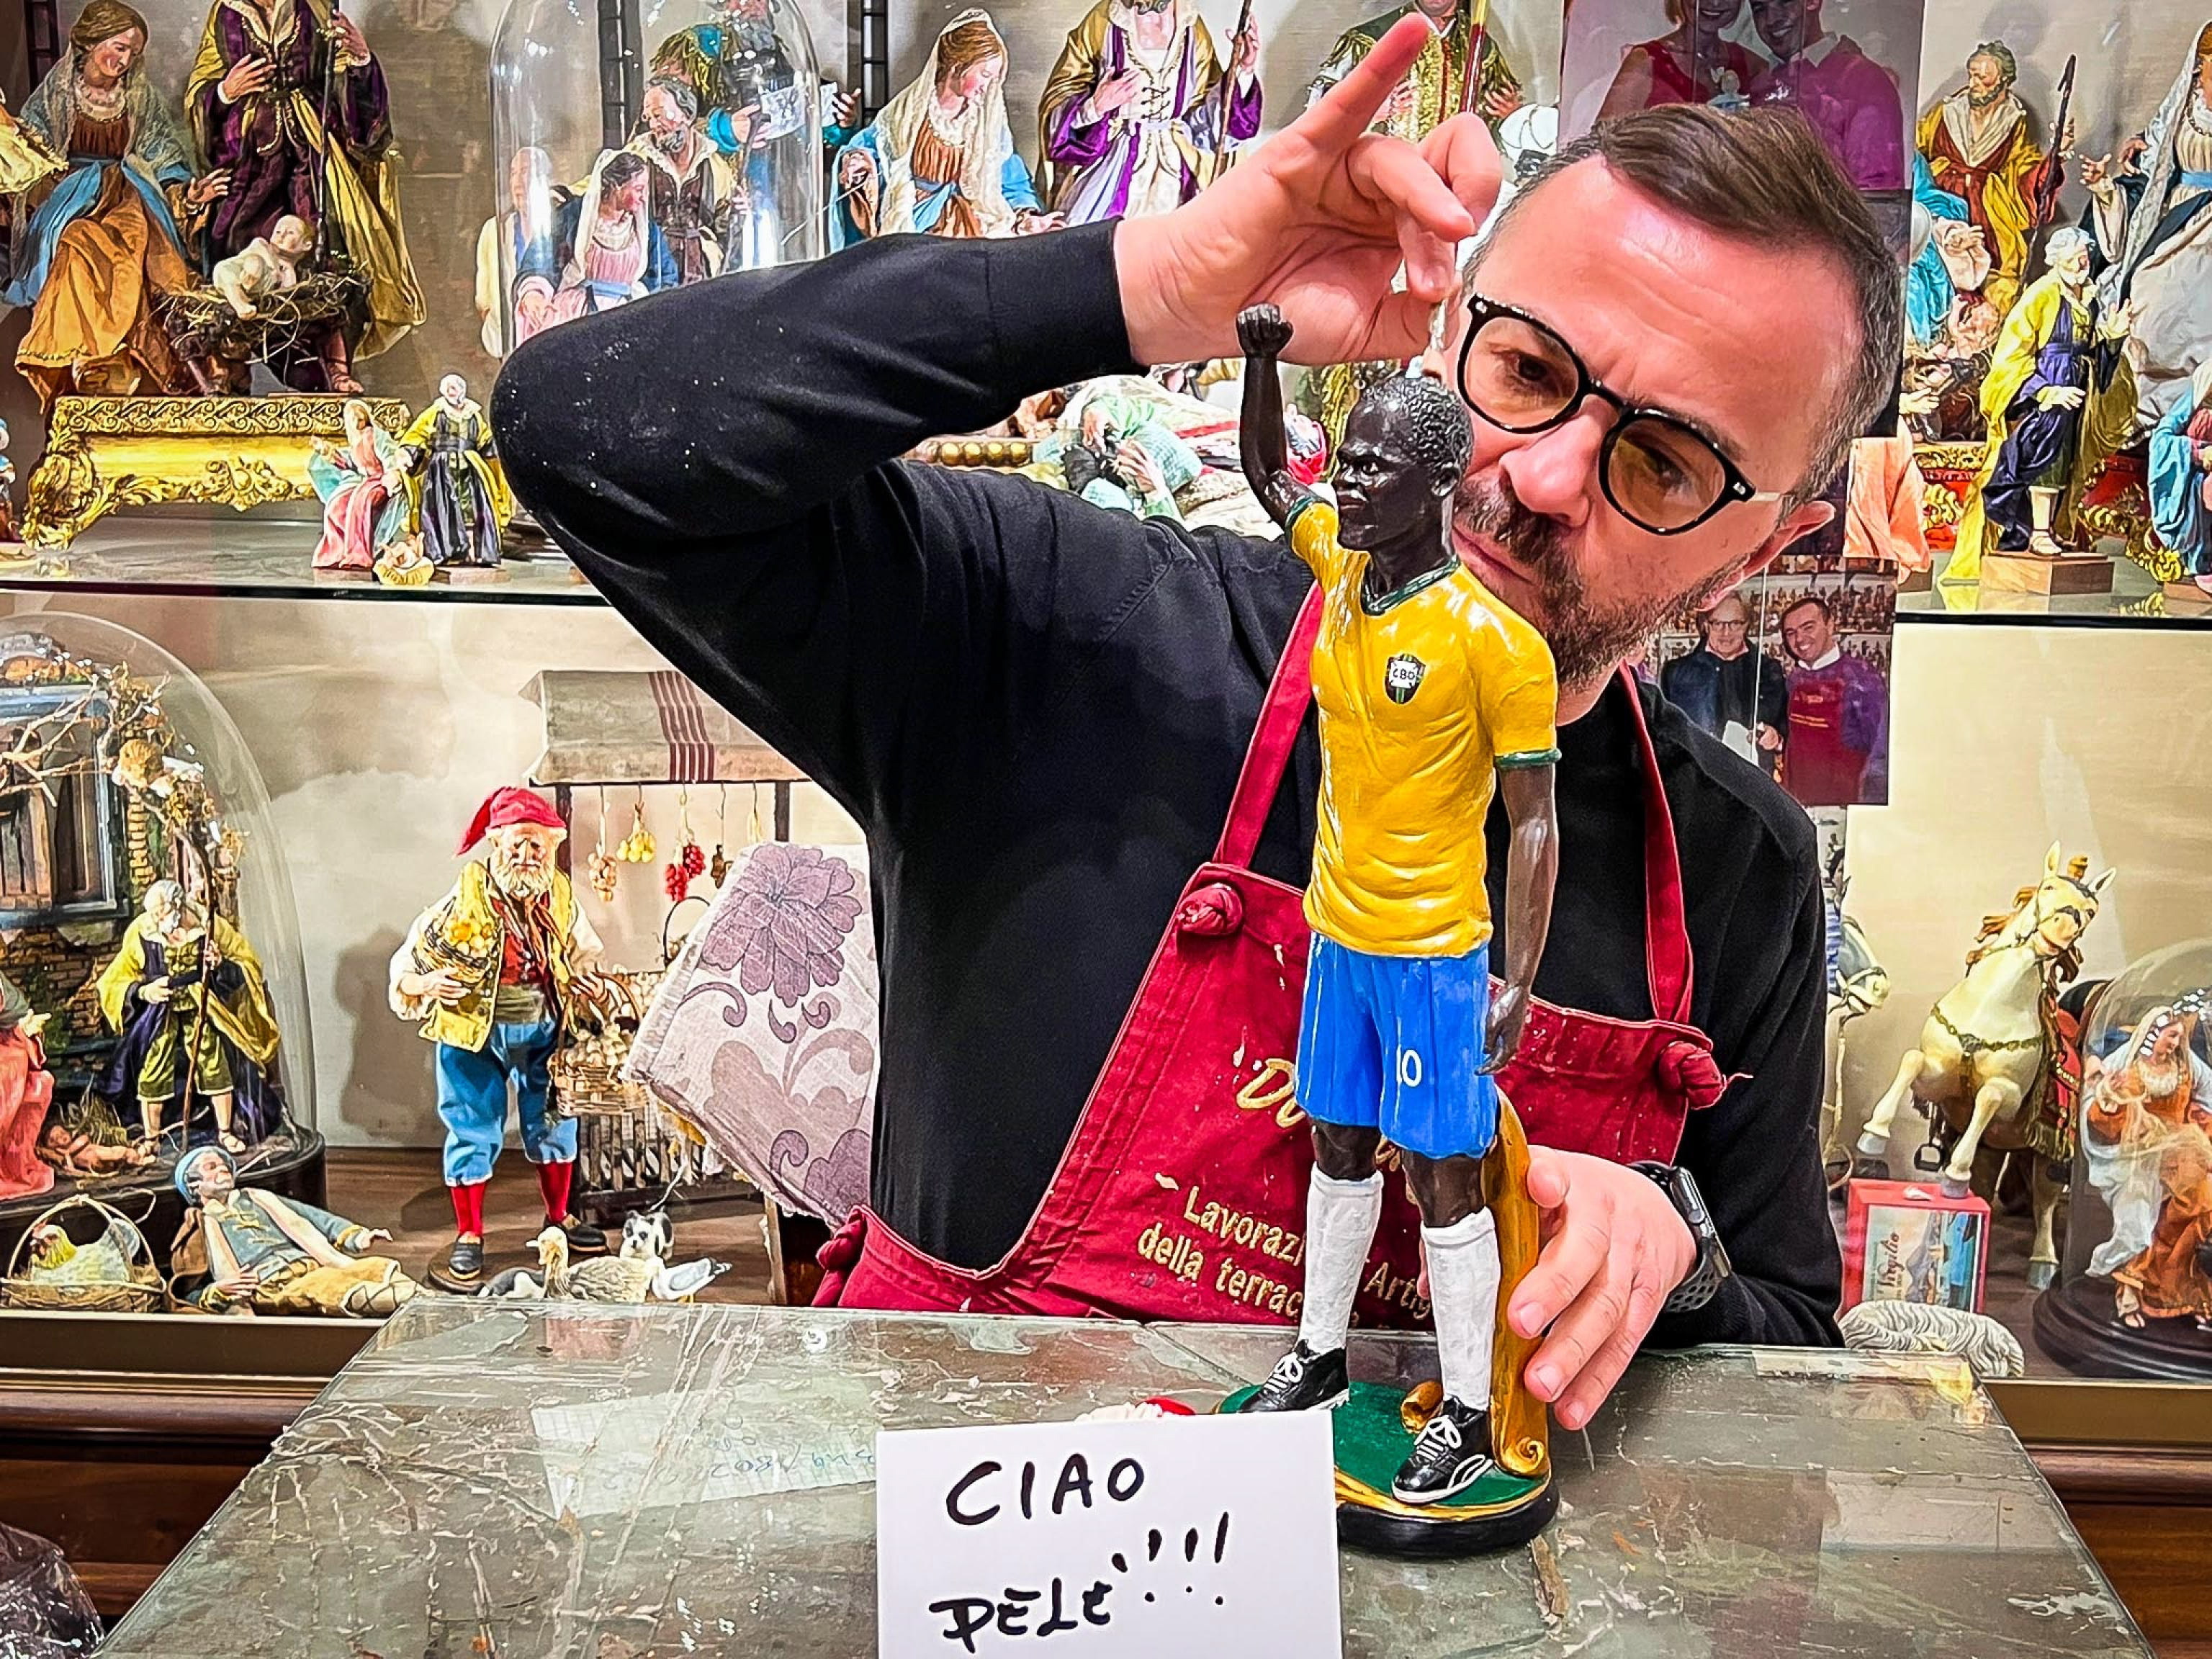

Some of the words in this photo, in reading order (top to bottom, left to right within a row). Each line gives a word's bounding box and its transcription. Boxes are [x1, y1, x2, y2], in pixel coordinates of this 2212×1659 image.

[1395, 1048, 1422, 1087] 10
[1138, 1222, 1205, 1281] della
[1215, 1256, 1303, 1317] terrac
[1183, 1185, 1305, 1267] Lavorazi
[1363, 1262, 1431, 1321] Artig
[945, 1453, 1145, 1526] CIAO
